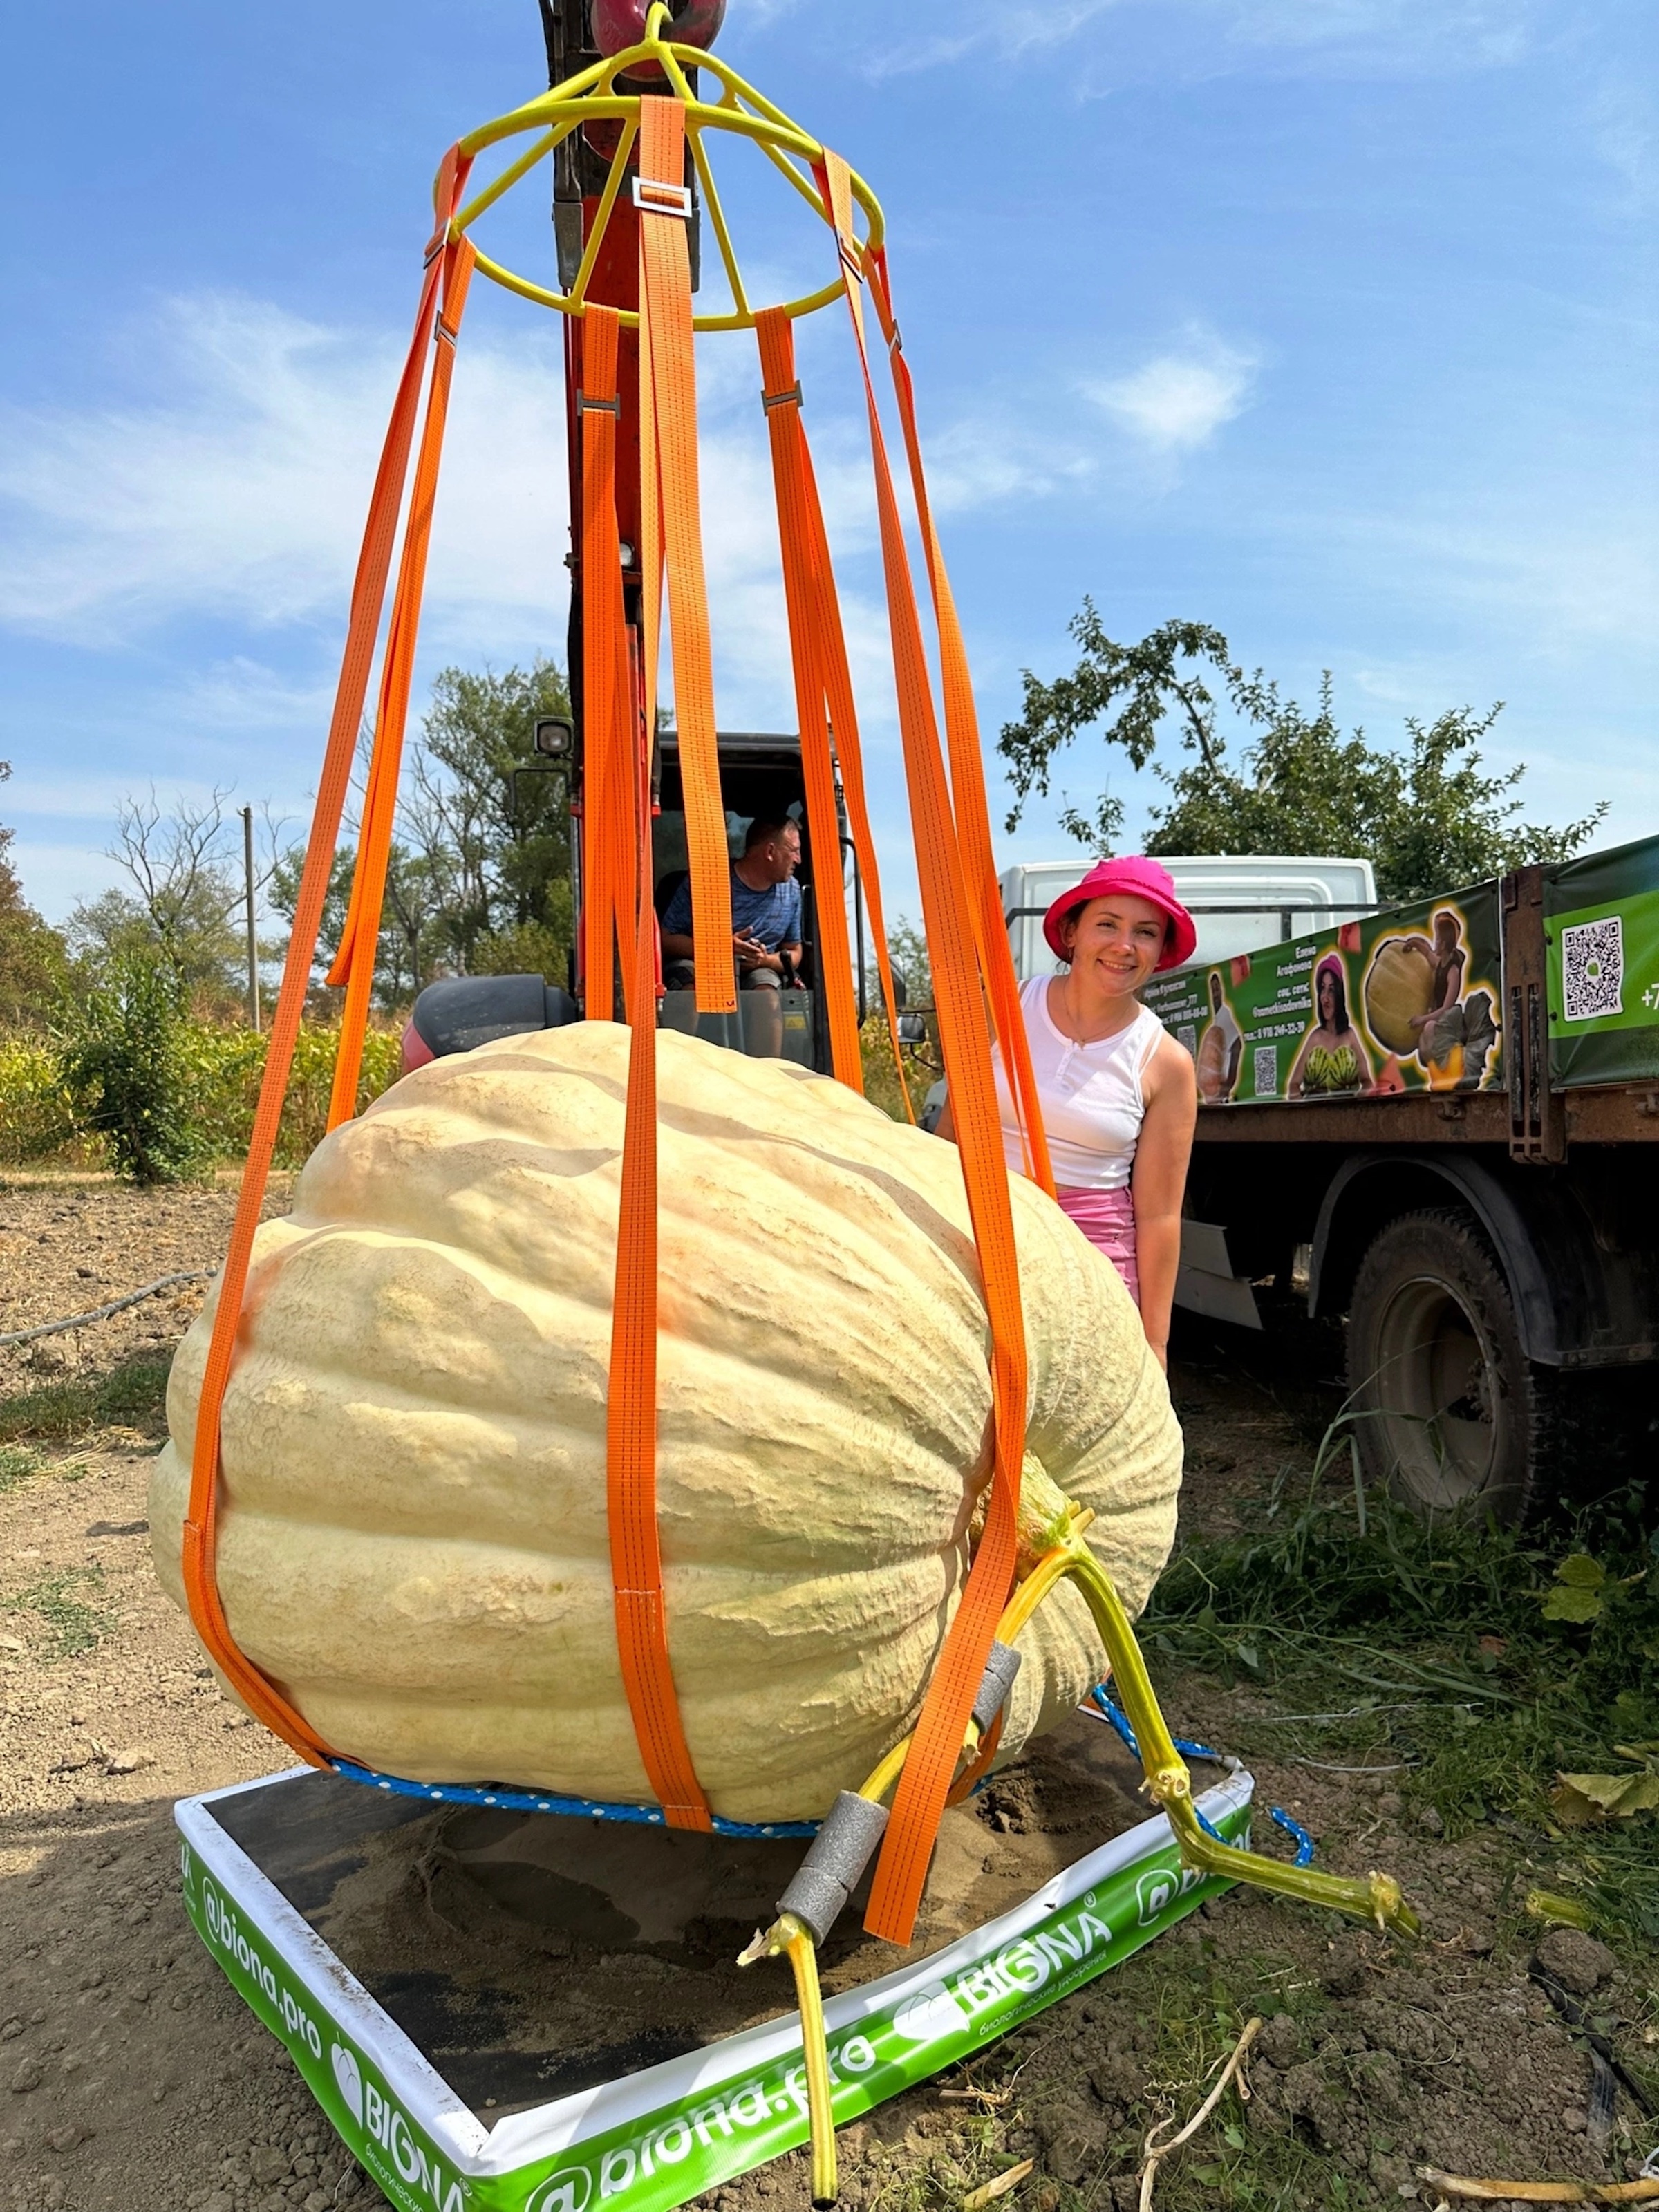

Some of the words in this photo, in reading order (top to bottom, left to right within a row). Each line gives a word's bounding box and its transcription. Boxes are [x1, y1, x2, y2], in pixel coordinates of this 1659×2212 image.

[1295, 946, 1316, 959] Елена
[1276, 960, 1312, 977] Агафонова
[203, 1876, 322, 2059] @biona.pro
